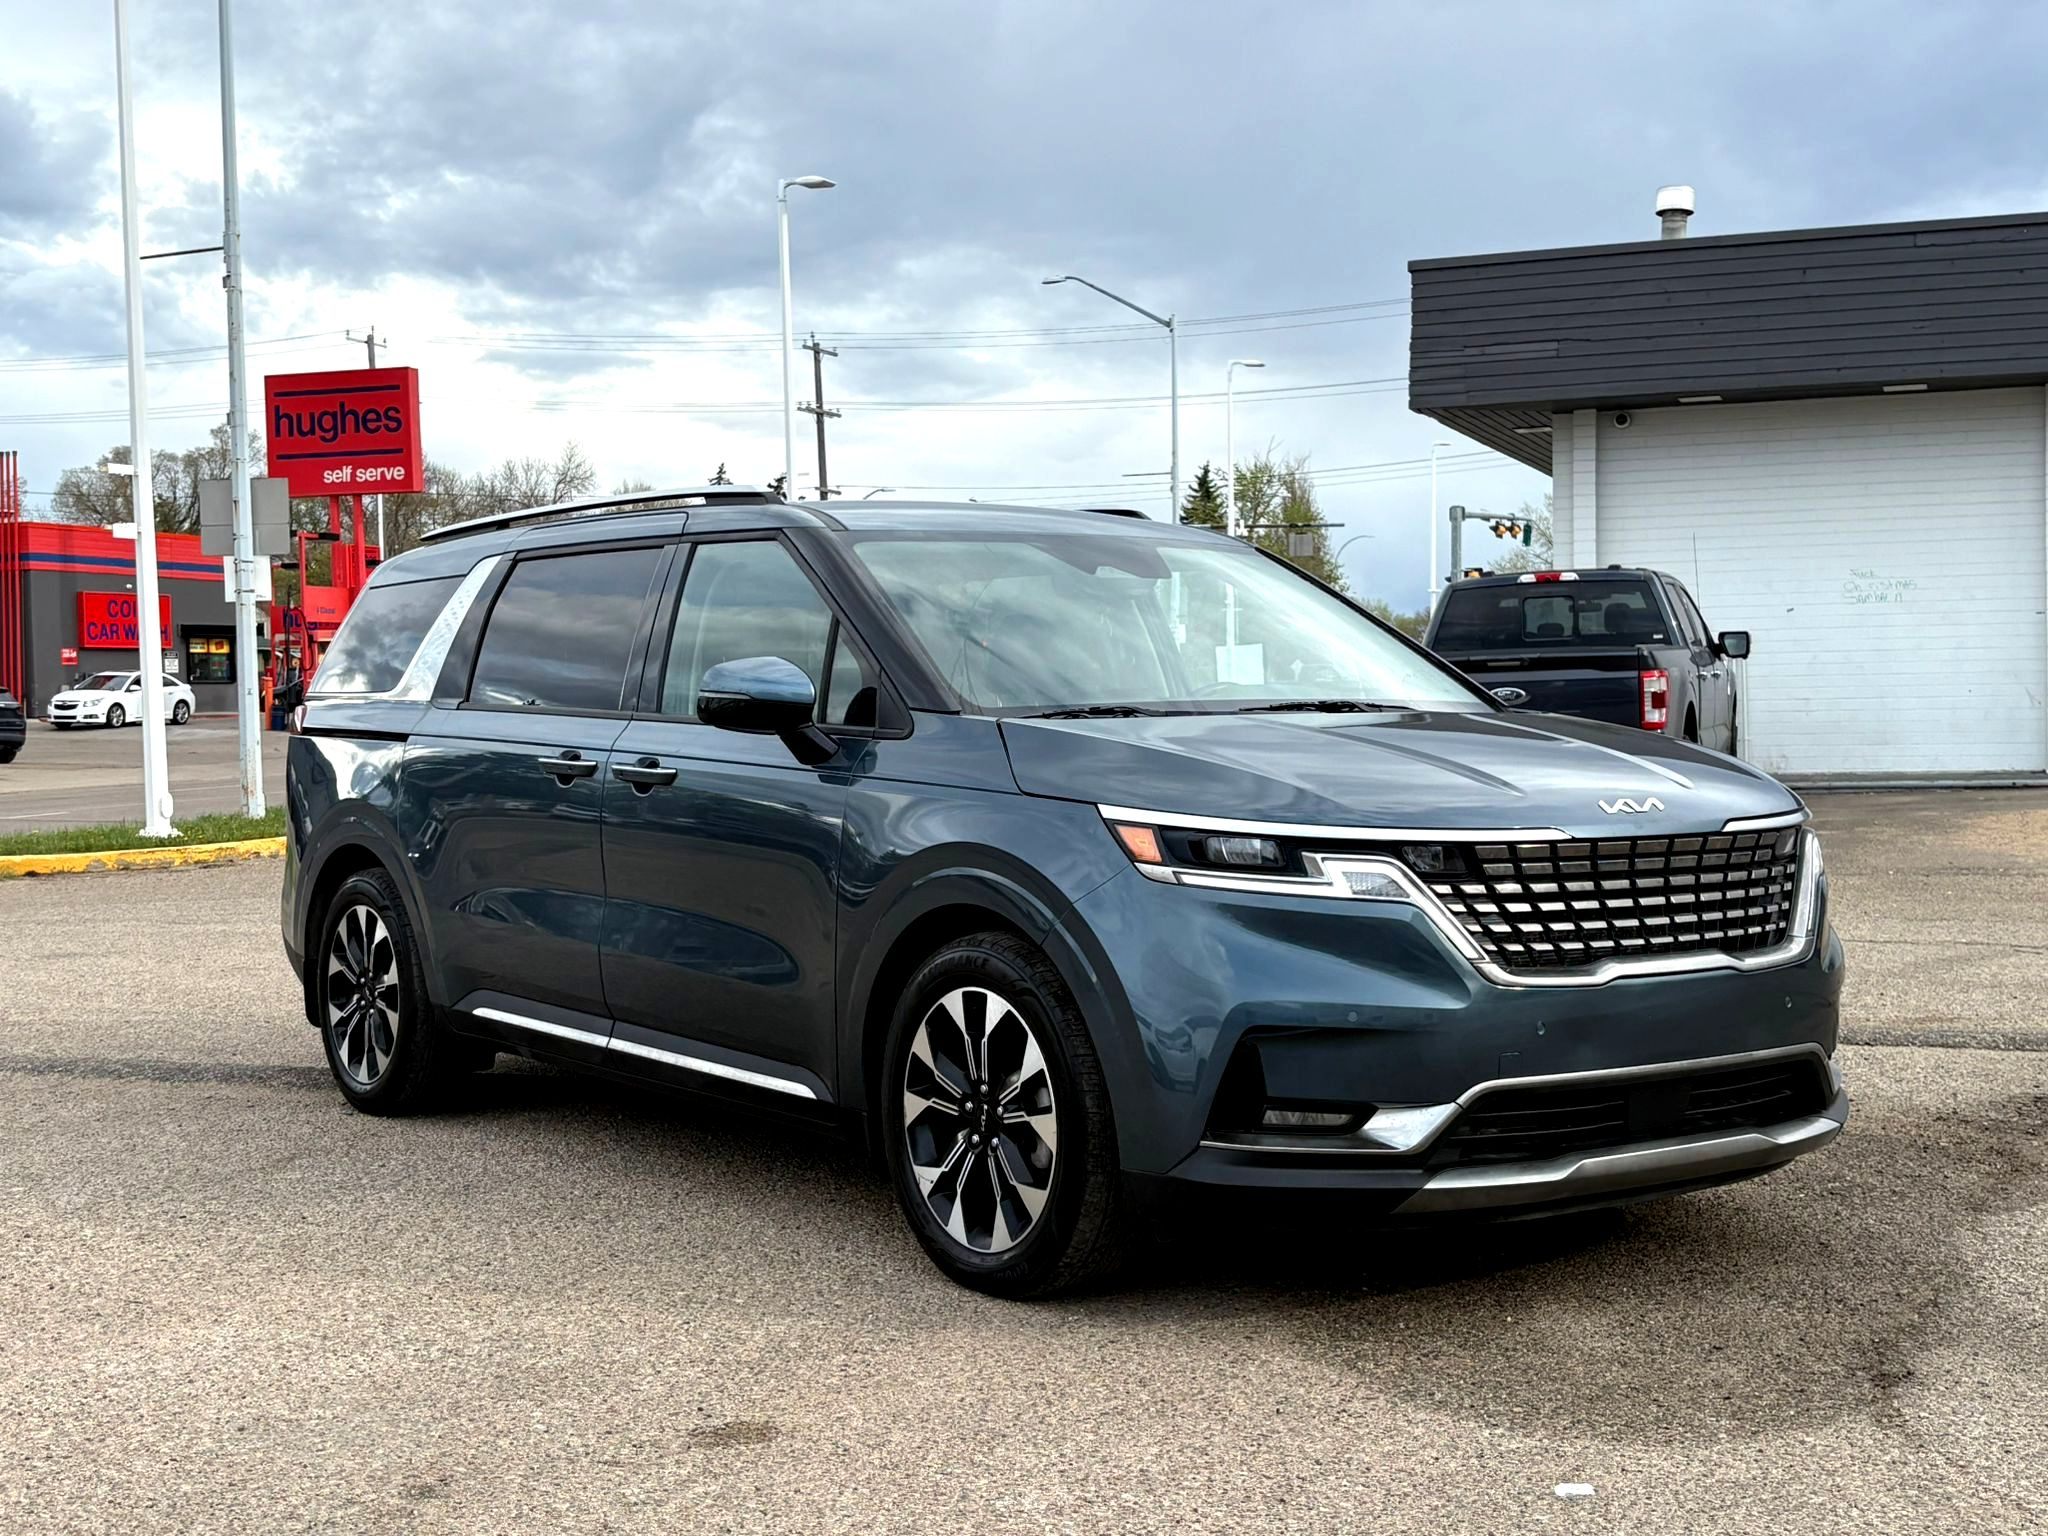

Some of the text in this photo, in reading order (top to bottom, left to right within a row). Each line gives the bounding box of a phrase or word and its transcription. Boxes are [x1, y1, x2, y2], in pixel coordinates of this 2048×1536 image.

[274, 401, 403, 443] hughes
[323, 465, 405, 483] self serve
[87, 622, 169, 641] CAR WH
